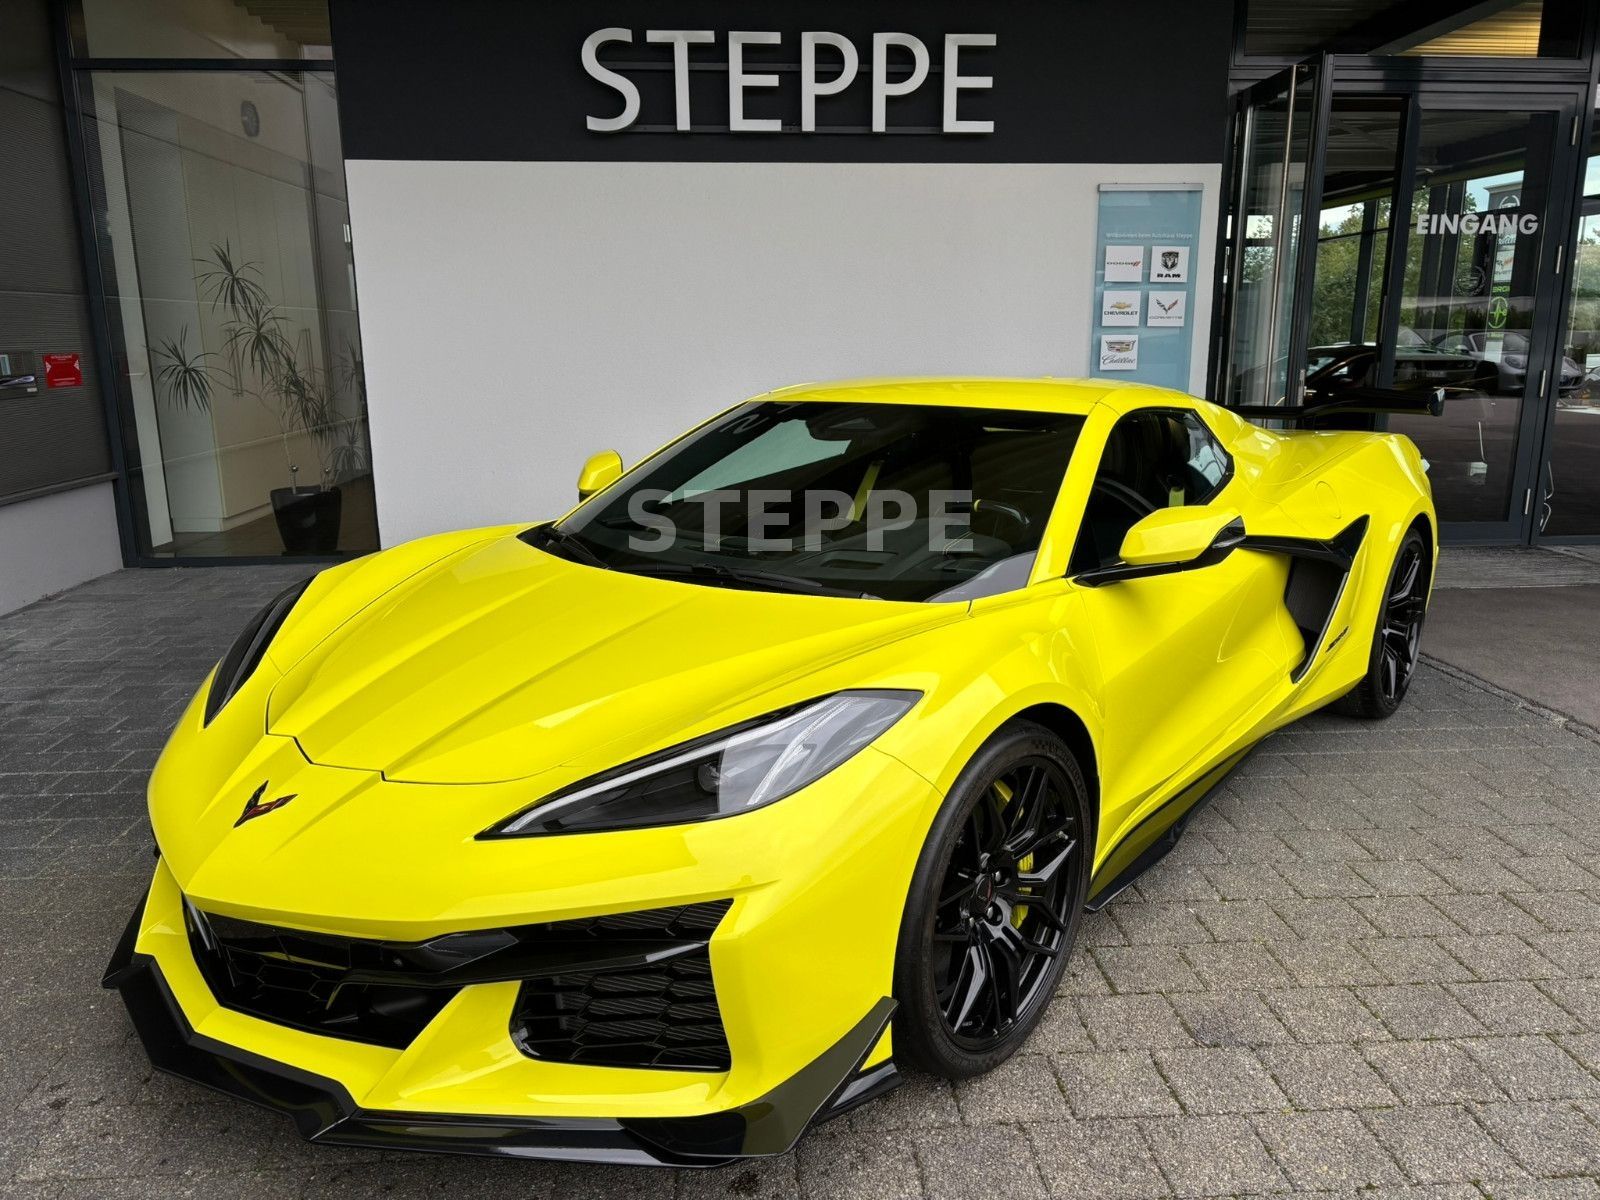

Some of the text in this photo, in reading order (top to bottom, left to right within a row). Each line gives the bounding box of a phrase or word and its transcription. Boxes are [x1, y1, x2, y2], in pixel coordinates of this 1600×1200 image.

[581, 27, 997, 133] STEPPE
[1416, 213, 1539, 235] EINGANG
[1101, 354, 1136, 365] Cadillac
